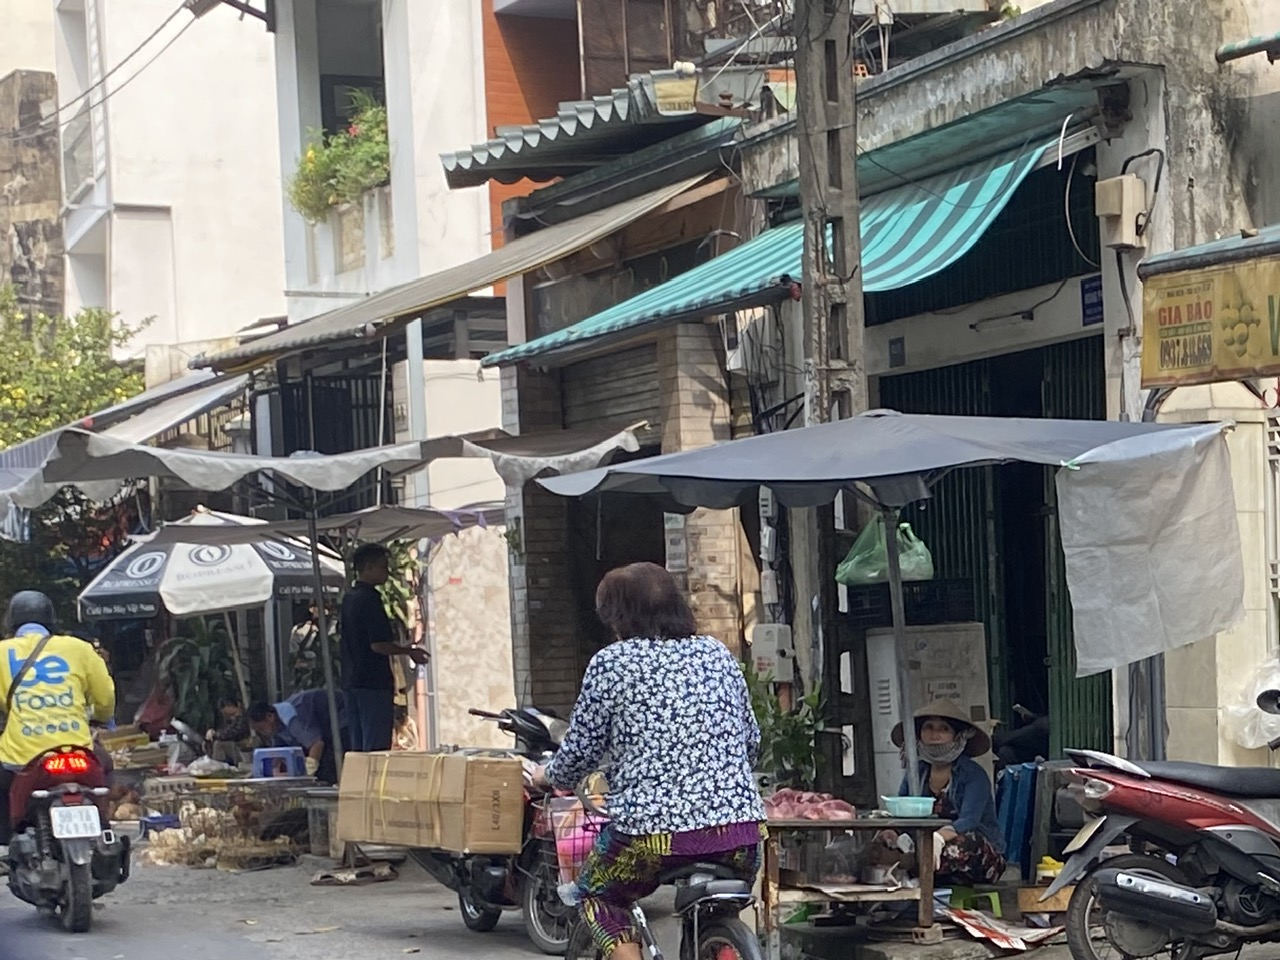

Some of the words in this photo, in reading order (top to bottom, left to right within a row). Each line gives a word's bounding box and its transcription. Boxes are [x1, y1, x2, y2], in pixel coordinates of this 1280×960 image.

[1158, 305, 1182, 327] GIA
[8, 648, 70, 687] be
[14, 686, 74, 711] Food
